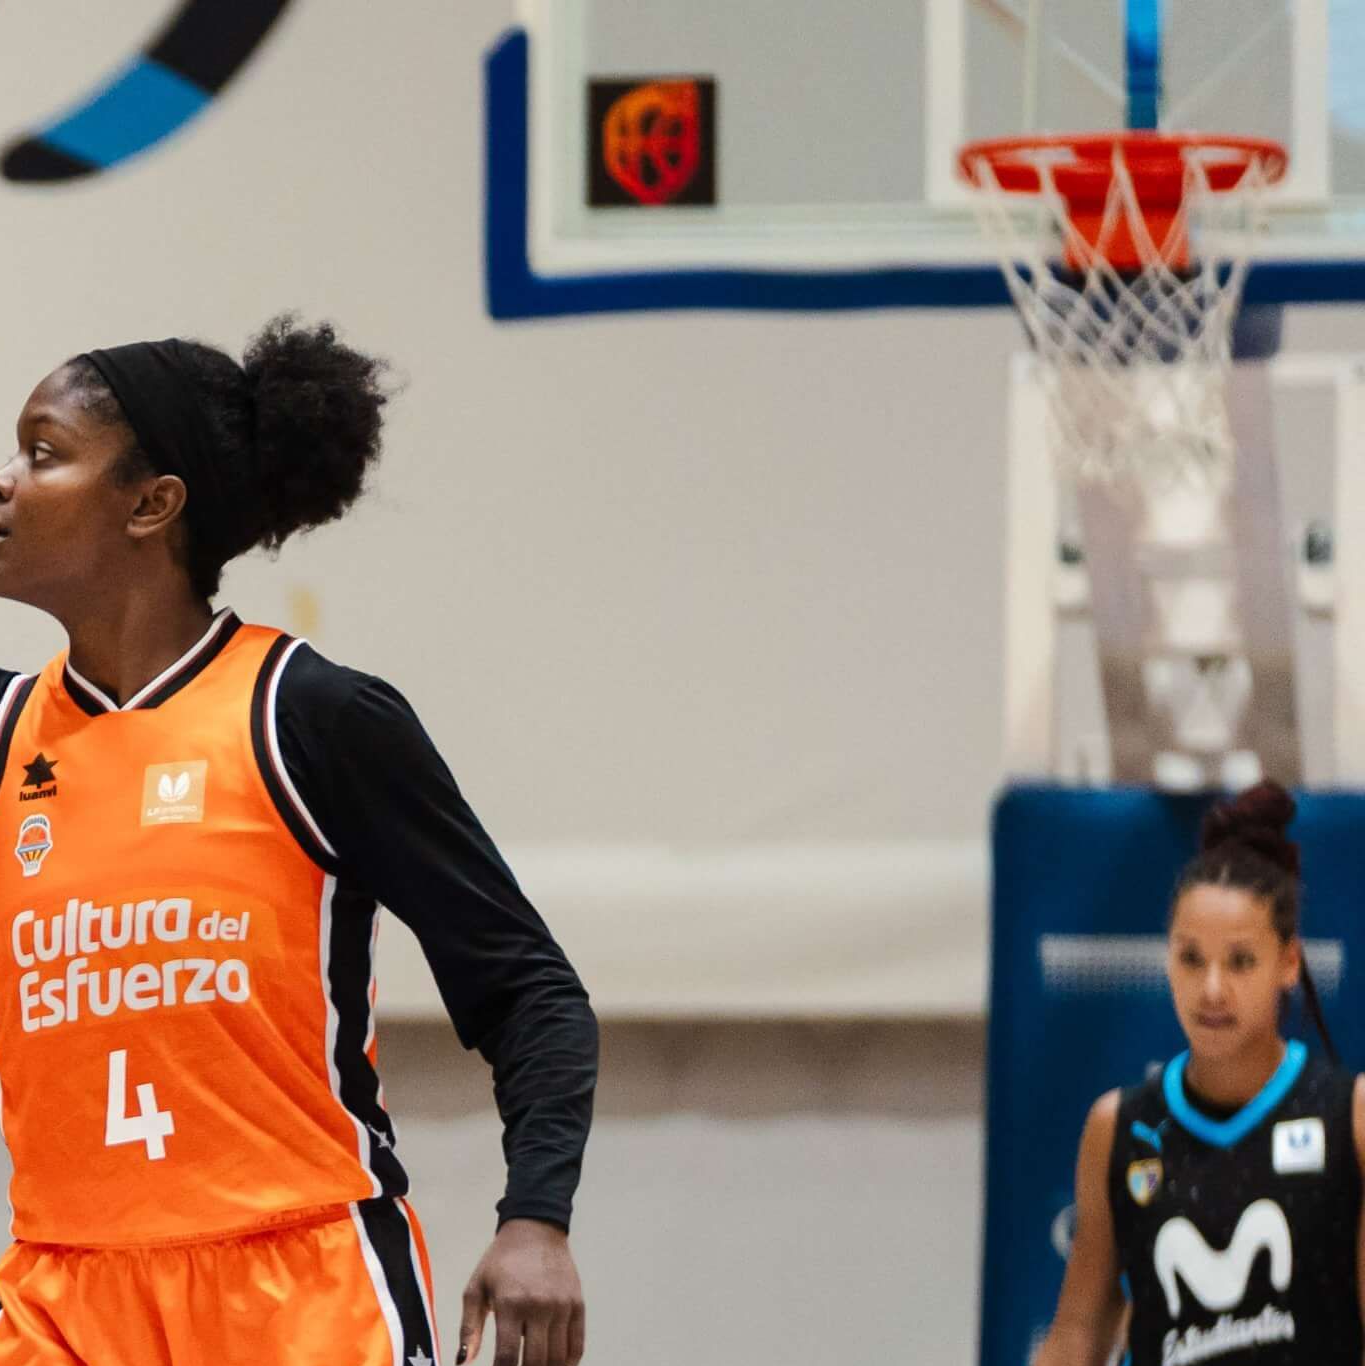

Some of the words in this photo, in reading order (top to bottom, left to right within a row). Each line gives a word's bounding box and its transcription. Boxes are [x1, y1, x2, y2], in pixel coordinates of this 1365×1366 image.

[12, 897, 191, 967] Cultura
[197, 910, 250, 942] del
[17, 958, 250, 1033] Esfuerzo
[105, 1048, 175, 1160] 4
